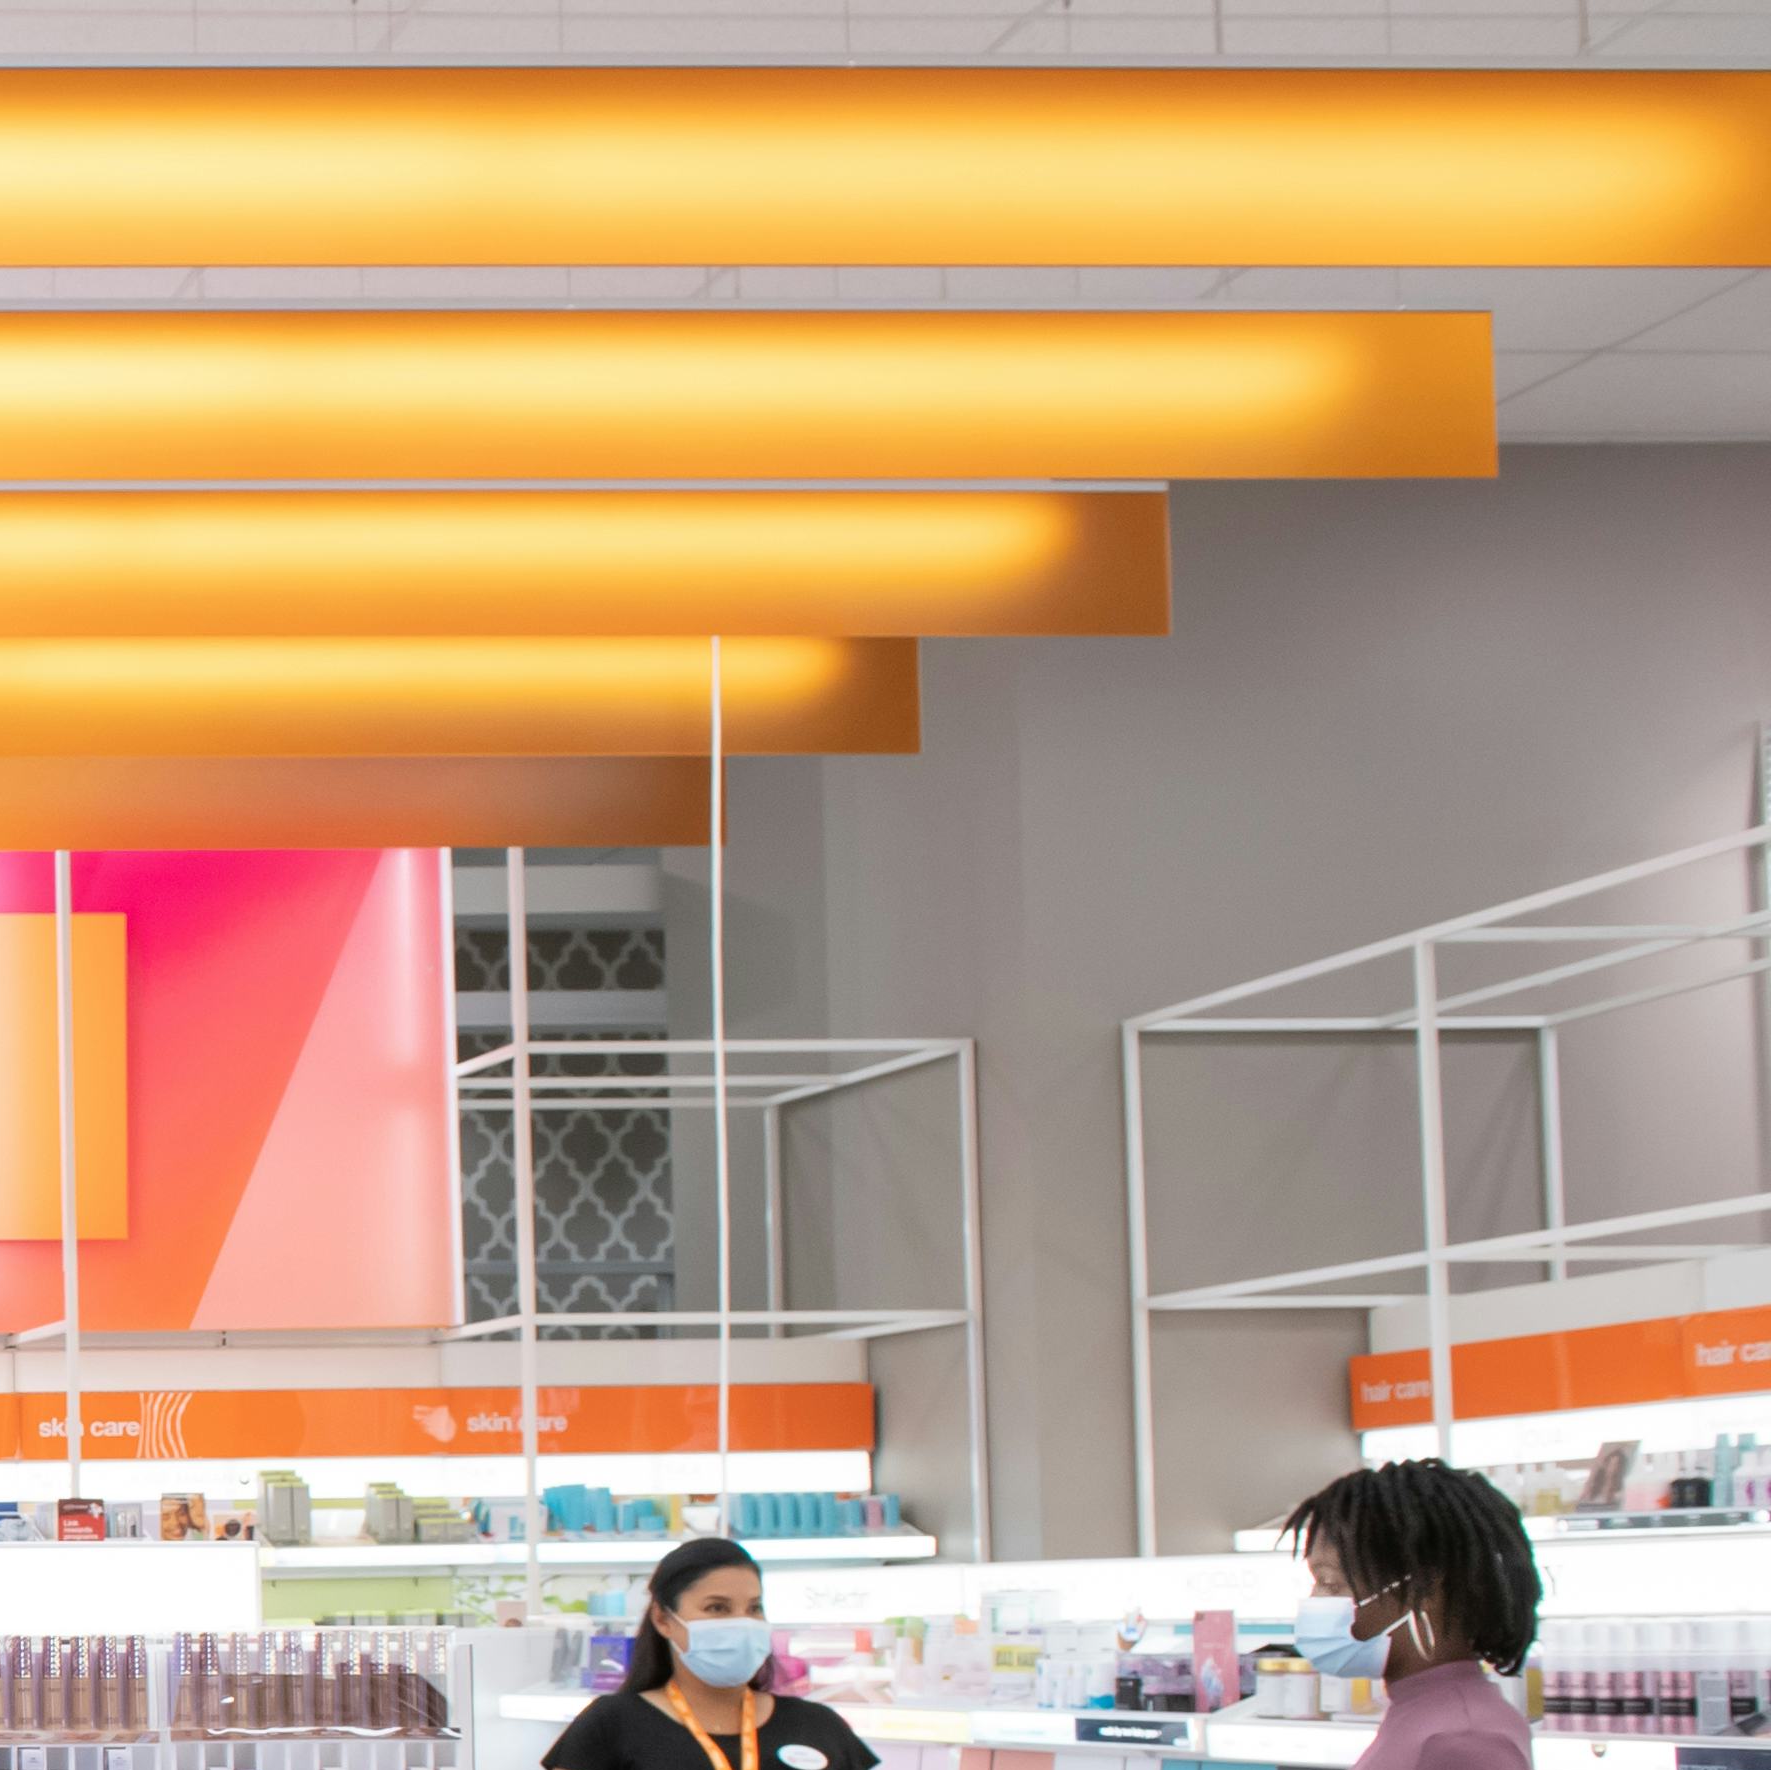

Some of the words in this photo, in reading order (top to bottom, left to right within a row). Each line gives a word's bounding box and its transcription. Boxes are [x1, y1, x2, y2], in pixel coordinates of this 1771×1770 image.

[1695, 1340, 1738, 1367] hair
[1361, 1380, 1394, 1403] hair
[1395, 1380, 1433, 1400] care
[39, 1418, 84, 1438] ski
[90, 1421, 140, 1437] care
[467, 1412, 512, 1432] skin
